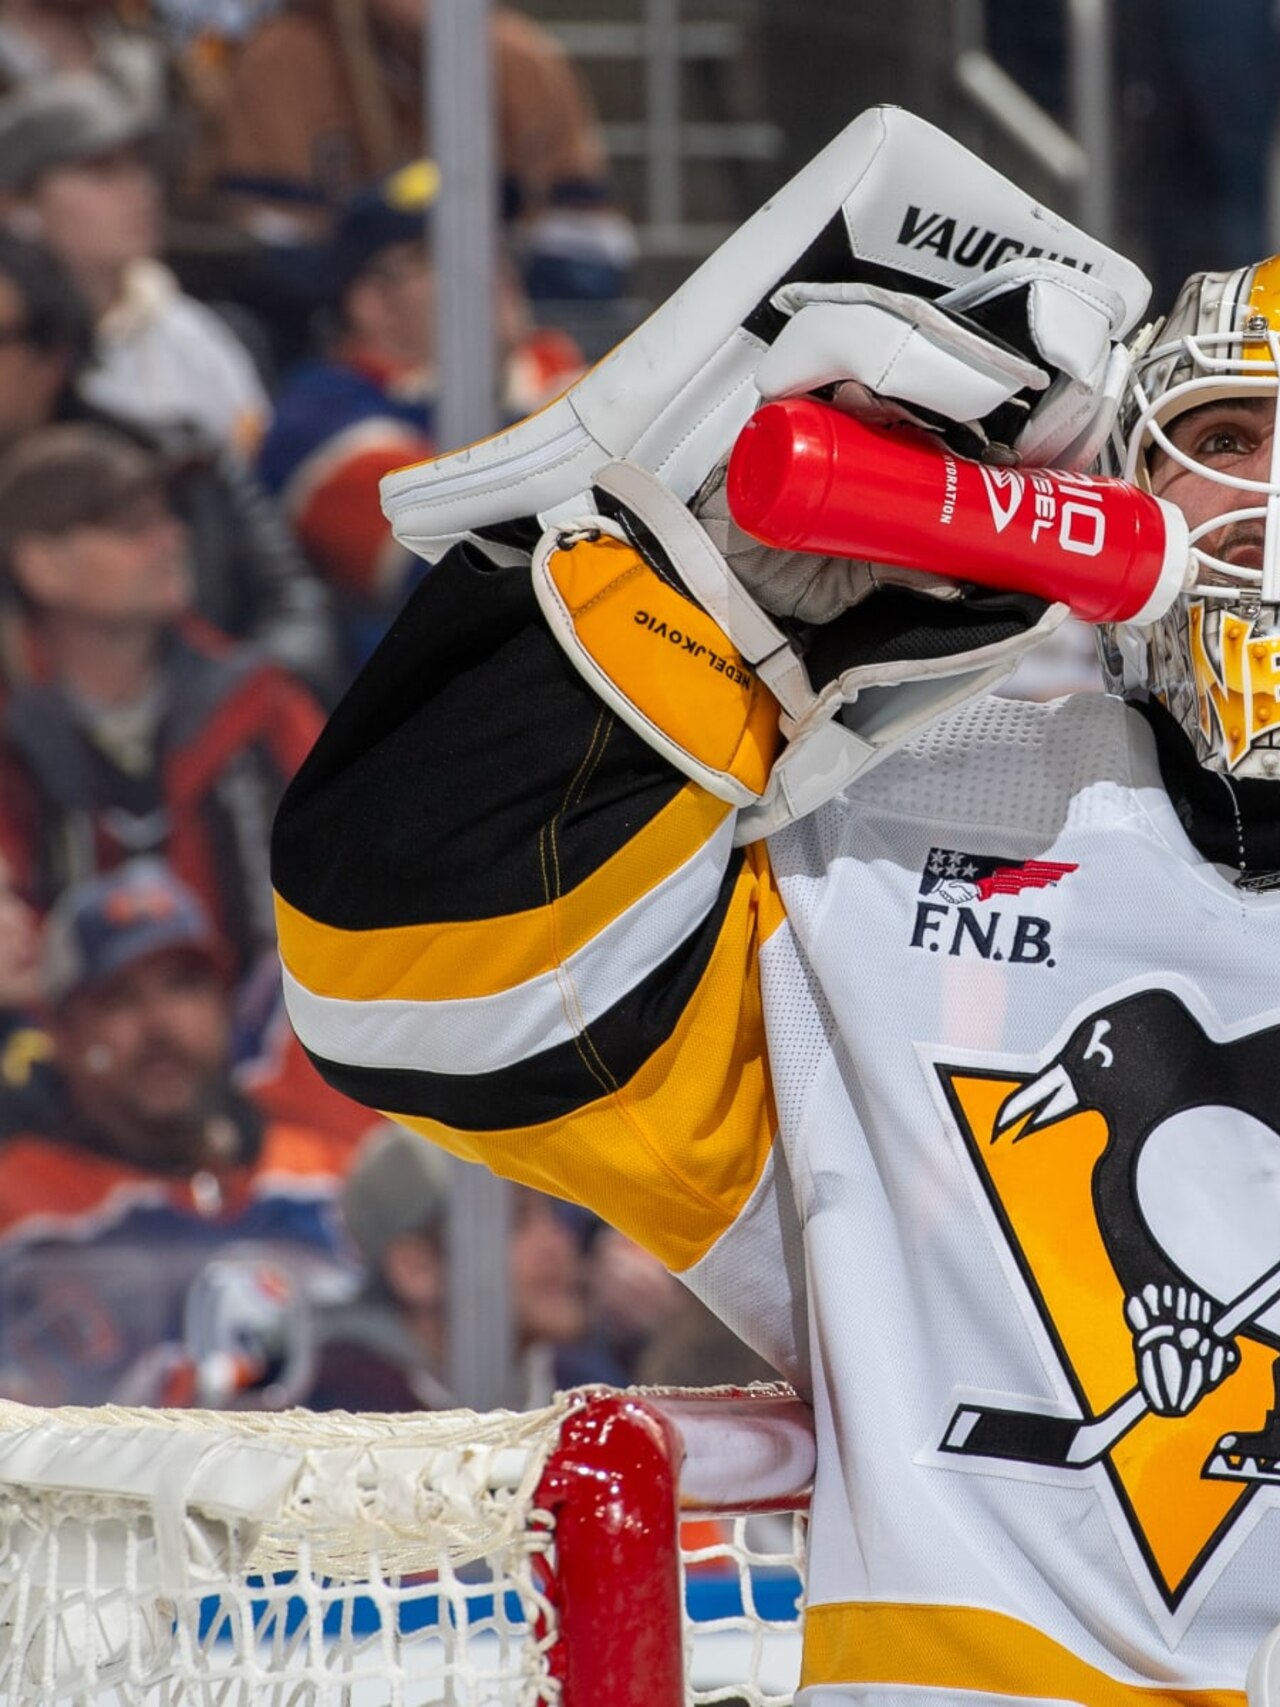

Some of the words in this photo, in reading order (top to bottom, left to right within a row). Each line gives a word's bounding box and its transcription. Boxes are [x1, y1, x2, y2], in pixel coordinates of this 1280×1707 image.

[896, 205, 1094, 273] VAUG
[634, 610, 751, 689] NEDELJKOVIC
[909, 901, 1055, 968] F.N.B.
